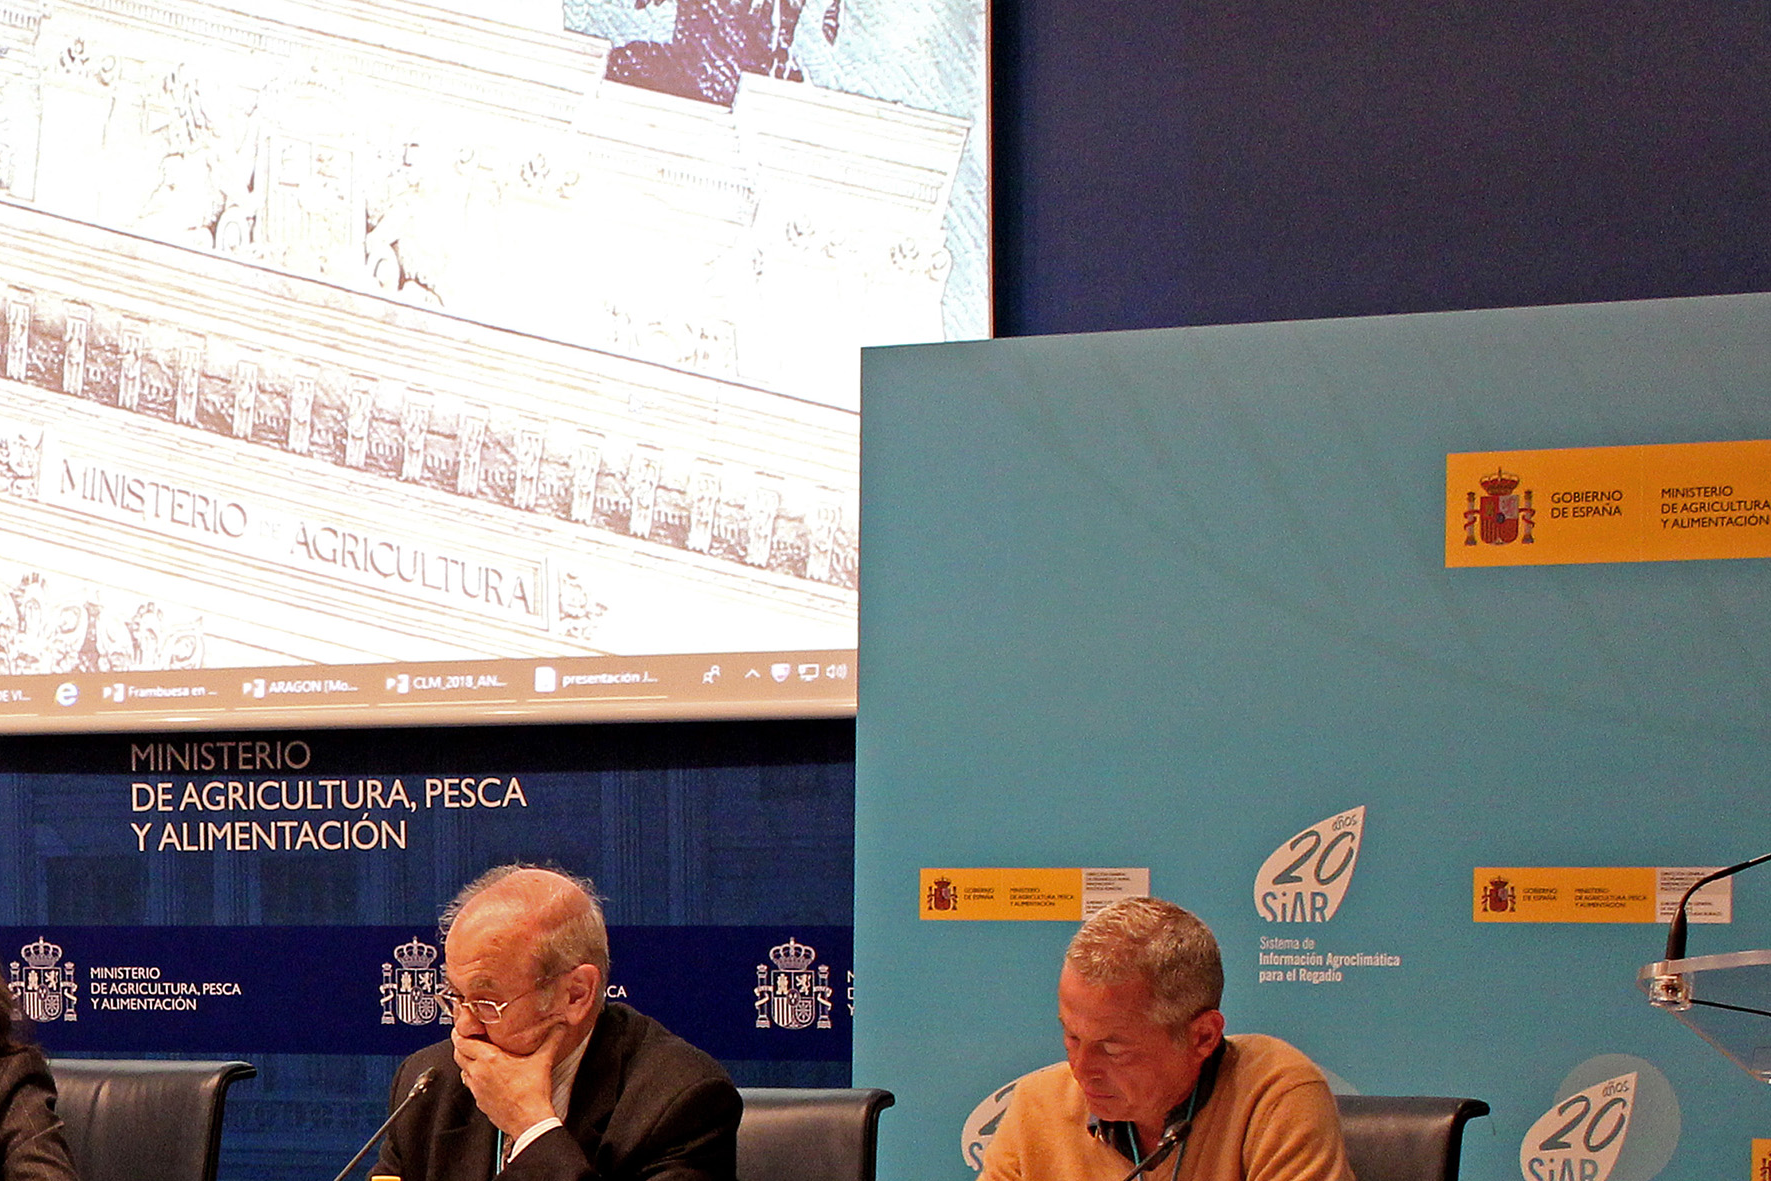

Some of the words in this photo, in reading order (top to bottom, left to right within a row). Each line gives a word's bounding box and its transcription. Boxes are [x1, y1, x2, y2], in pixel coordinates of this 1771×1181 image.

[1550, 490, 1623, 504] GOBIERNO
[1660, 485, 1734, 499] MINISTERIO
[1550, 506, 1569, 519] DE
[1572, 502, 1622, 518] ESPAÑA
[1660, 502, 1679, 514] DE
[1660, 518, 1668, 529] Y
[1670, 513, 1770, 529] ALIMENTACIÓN
[59, 458, 248, 538] MINISTERIO
[289, 521, 532, 616] AGRICULTURA
[562, 670, 641, 688] presentación
[128, 685, 188, 699] Frambuesa
[191, 687, 205, 697] en
[131, 740, 312, 772] MINISTERIO
[131, 782, 173, 812] DE
[179, 779, 417, 813] AGRICULTURA,
[425, 777, 528, 809] PESCA
[1332, 814, 1357, 832] años
[131, 822, 152, 851] Y
[158, 813, 407, 851] ALIMENTACIÓN
[1272, 830, 1355, 886] 20
[1259, 936, 1300, 950] Sistema
[1302, 936, 1315, 950] de
[1259, 952, 1323, 966] Información
[1326, 952, 1401, 968] Agroclimática
[90, 967, 161, 980] MINISTERIO
[1259, 969, 1283, 983] para
[1286, 968, 1296, 981] el
[91, 983, 108, 995] DE
[109, 982, 201, 996] AGRICULTURA,
[202, 983, 242, 996] PESCA
[91, 998, 99, 1010] Y
[101, 996, 197, 1011] ALIMENTACIÓN
[1602, 1080, 1630, 1098] años
[1539, 1095, 1626, 1153] 20
